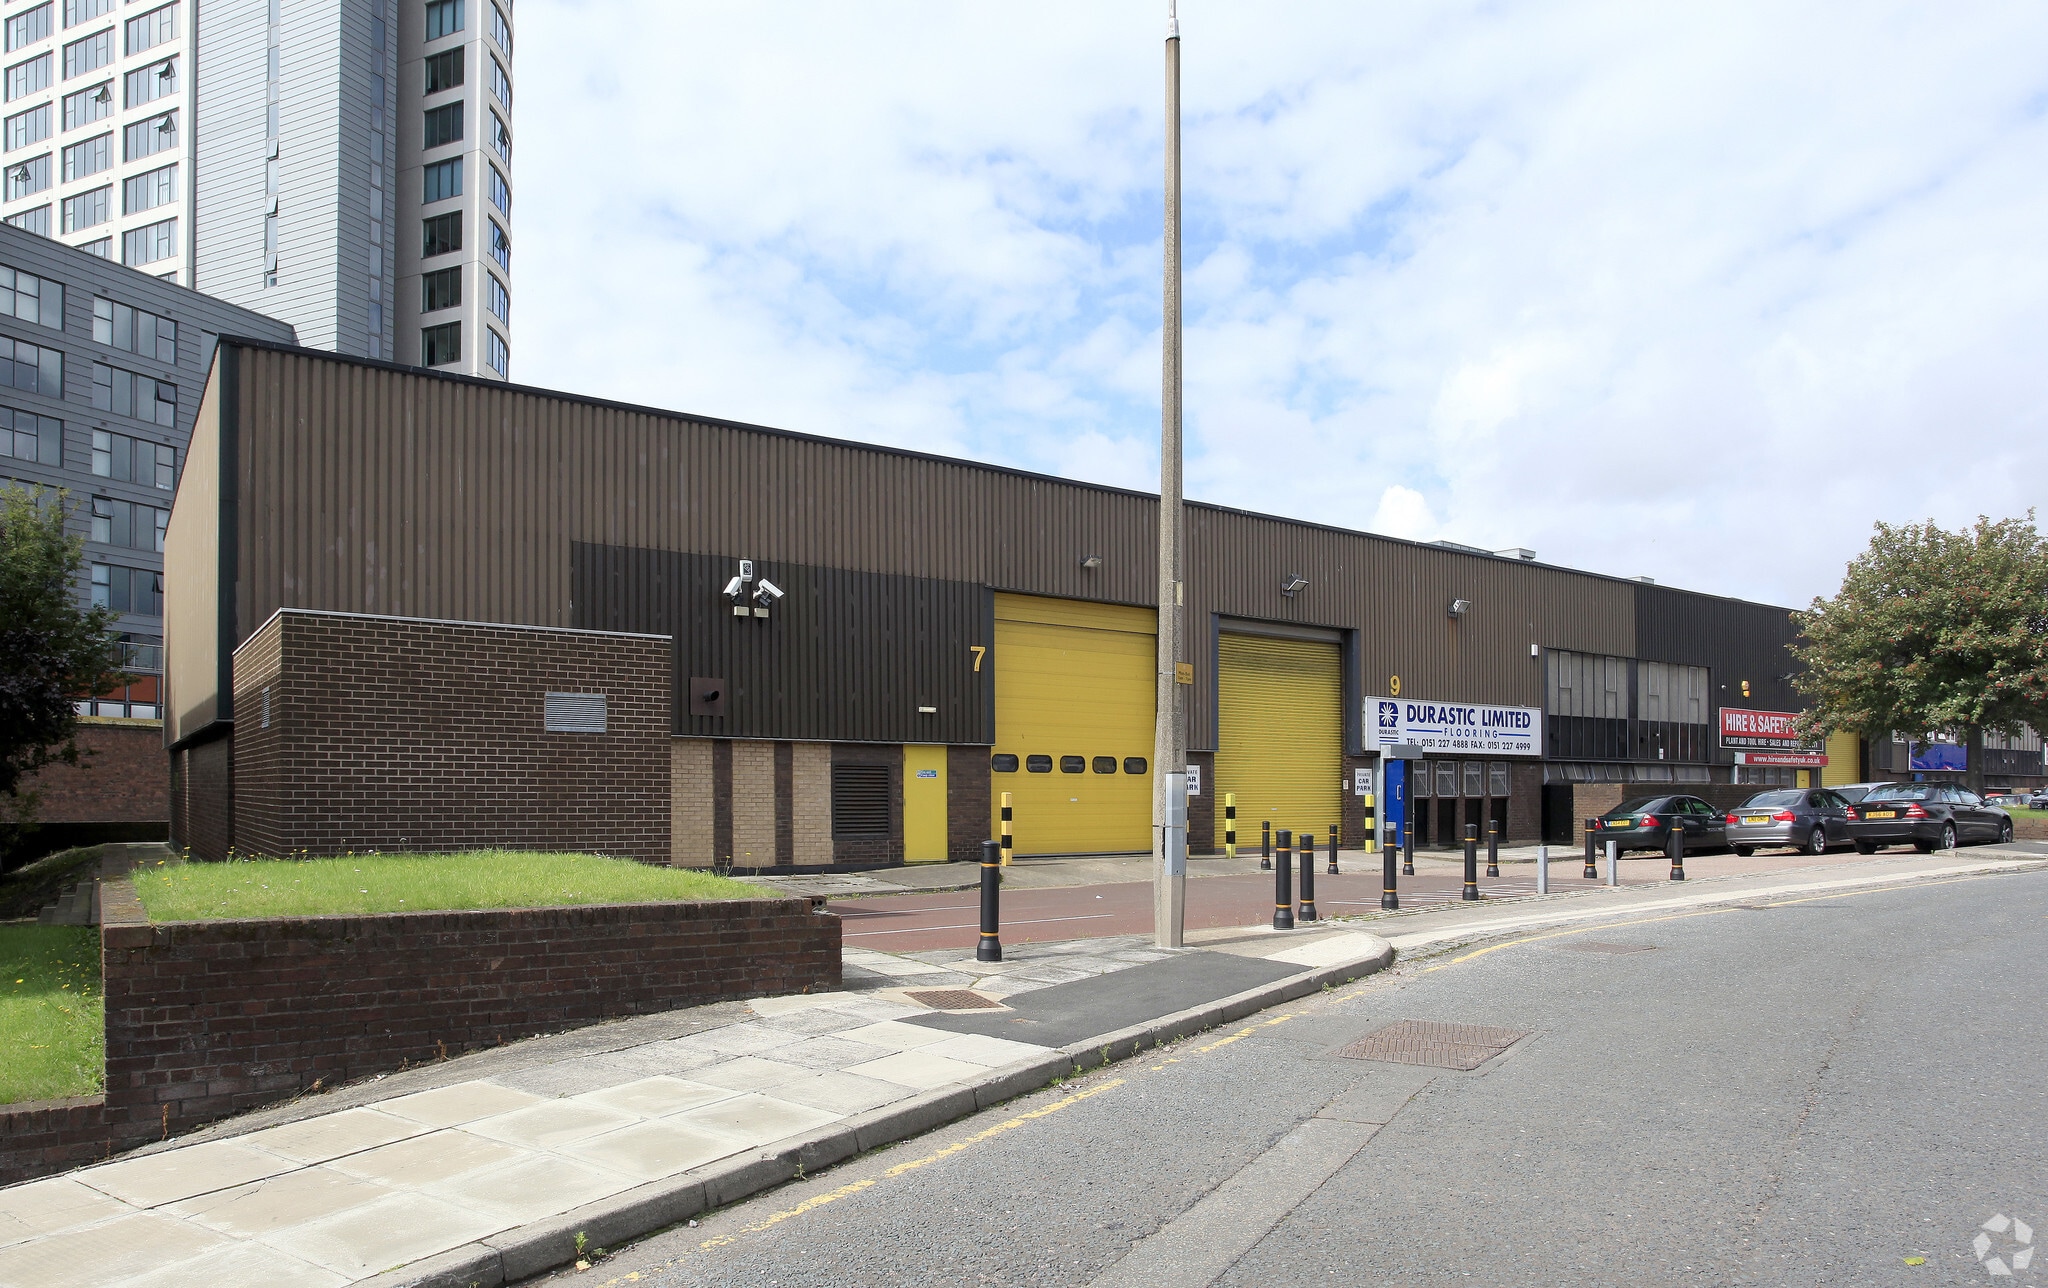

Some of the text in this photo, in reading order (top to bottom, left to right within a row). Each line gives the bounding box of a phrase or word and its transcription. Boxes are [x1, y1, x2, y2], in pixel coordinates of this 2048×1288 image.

[970, 645, 986, 672] 7
[1390, 675, 1401, 696] 9
[1406, 704, 1531, 729] DURASTIC LIMITED
[1725, 713, 1748, 732] HIRE
[1750, 714, 1757, 733] &
[1444, 727, 1498, 738] FLOORING
[1725, 737, 1739, 745] PLANT
[1739, 737, 1747, 745] AND
[1747, 737, 1757, 746] TOOL
[1758, 738, 1767, 746] HIRE
[1769, 738, 1781, 747] SALES
[1782, 739, 1790, 747] AND
[1421, 739, 1436, 748] 0151
[1438, 739, 1450, 748] 227
[1453, 740, 1469, 749] 4888
[1470, 740, 1485, 749] FAX:
[1487, 741, 1500, 749] 0151
[1502, 741, 1513, 750] 227
[1515, 742, 1531, 750] 4999
